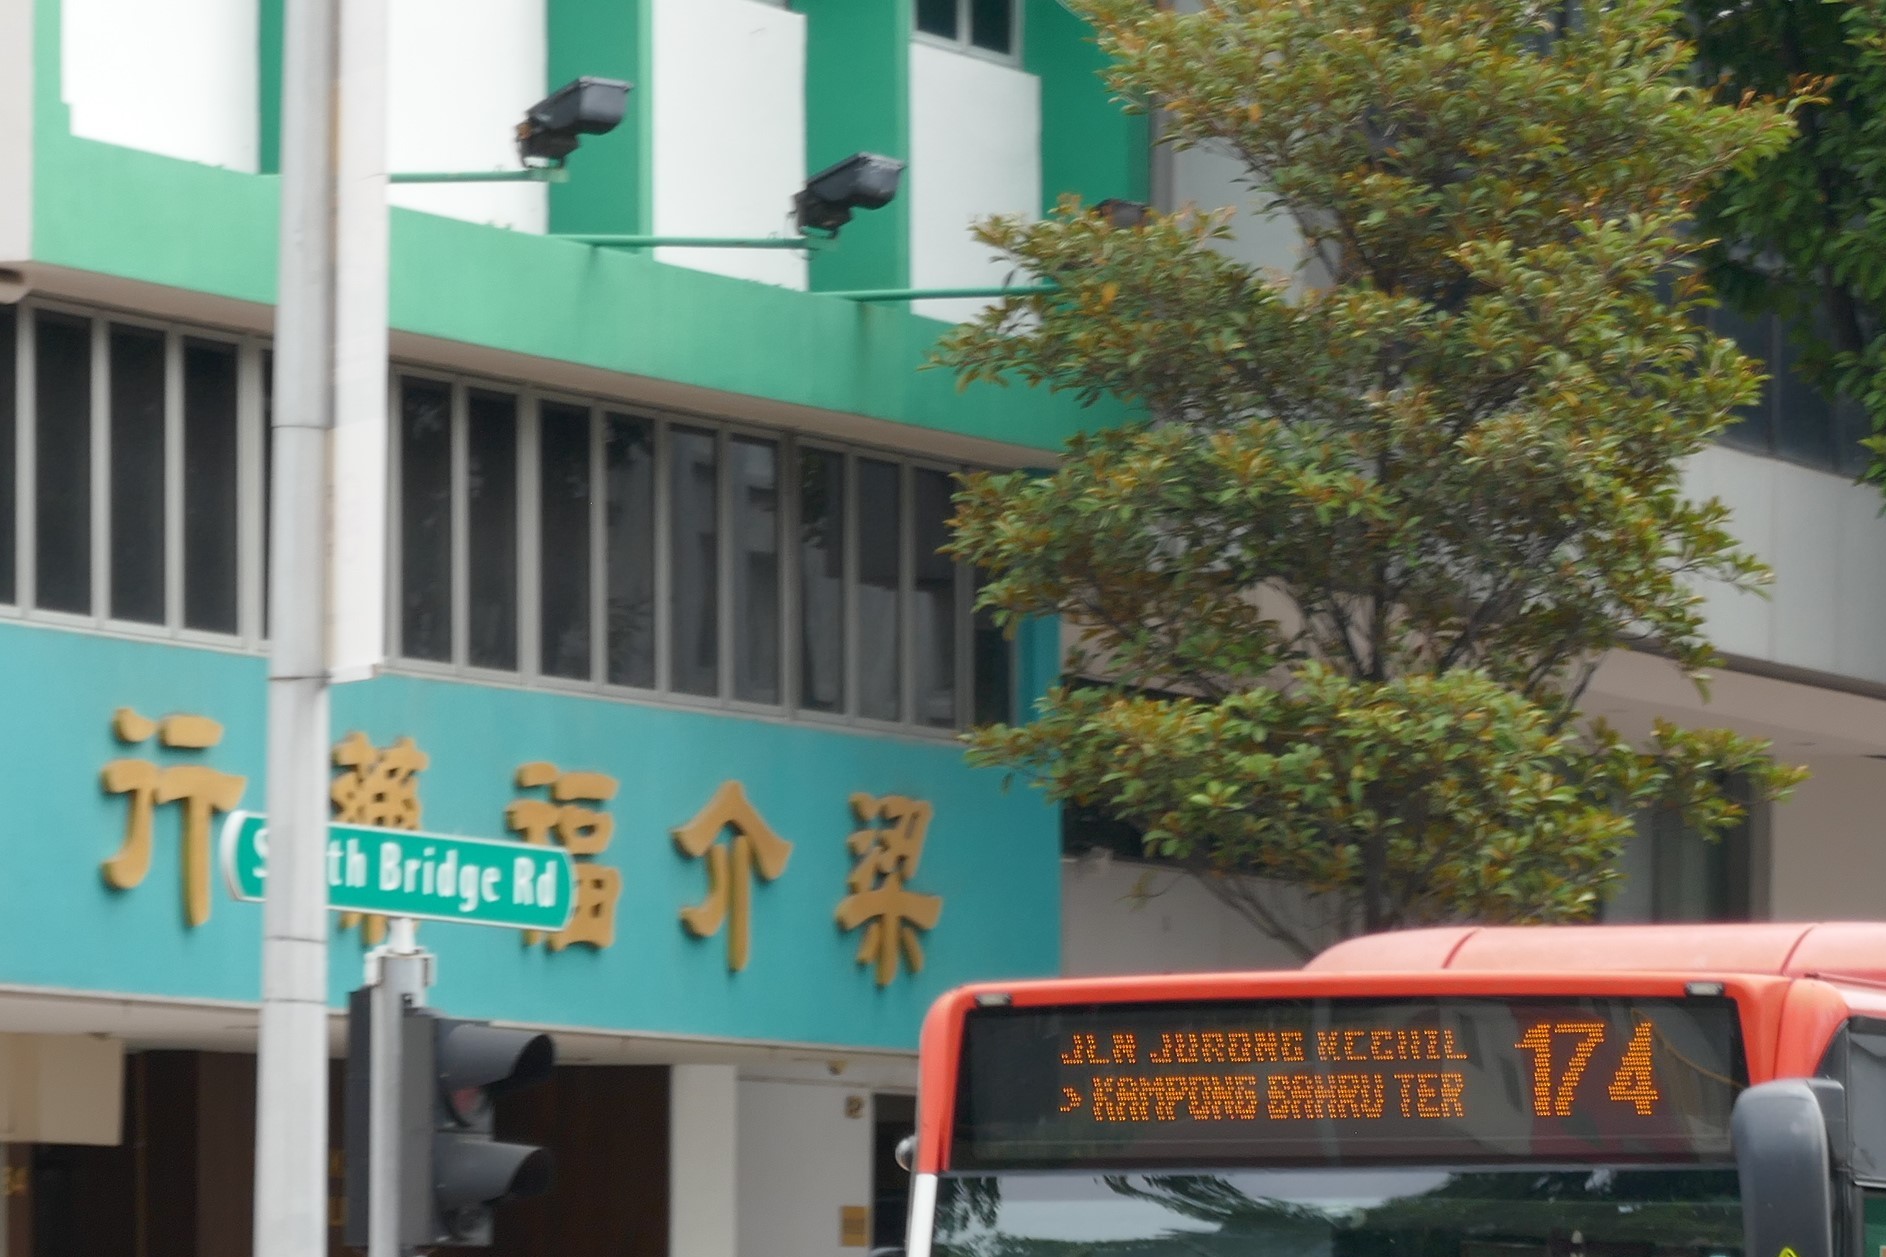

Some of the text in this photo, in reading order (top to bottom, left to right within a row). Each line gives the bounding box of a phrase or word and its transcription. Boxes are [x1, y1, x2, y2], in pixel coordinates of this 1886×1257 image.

[252, 827, 557, 912] Sth Bridge Rd
[1061, 1032, 1137, 1065] JLN
[1150, 1031, 1306, 1063] JURONG
[1514, 1022, 1660, 1117] 174
[1091, 1073, 1465, 1122] KAMPONG BAHRU TER
